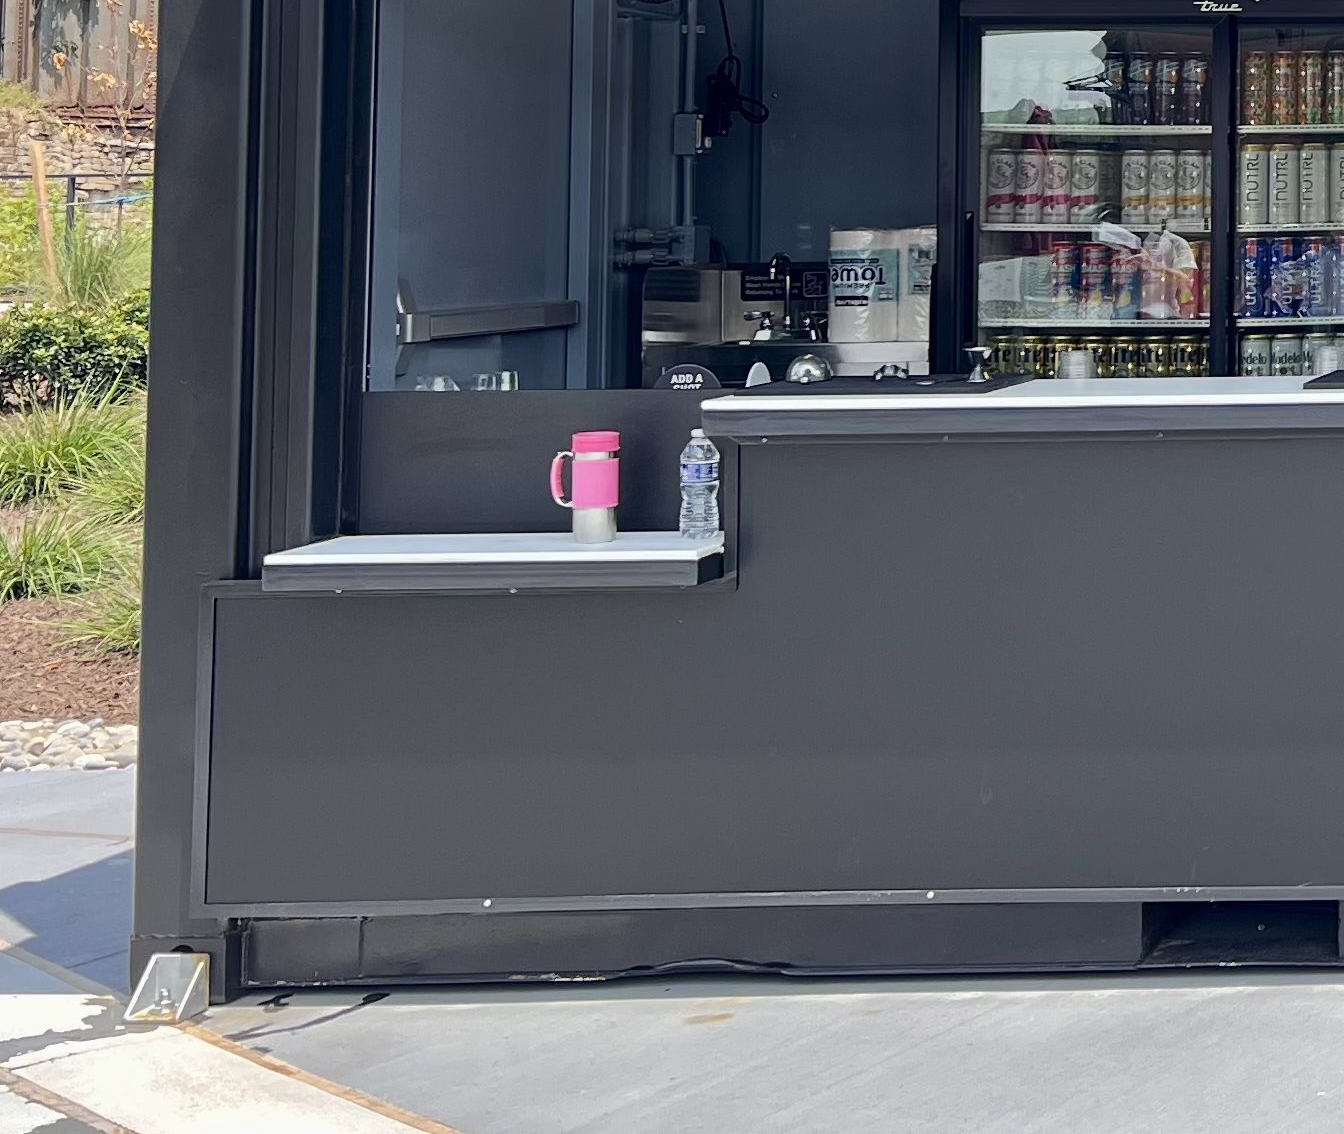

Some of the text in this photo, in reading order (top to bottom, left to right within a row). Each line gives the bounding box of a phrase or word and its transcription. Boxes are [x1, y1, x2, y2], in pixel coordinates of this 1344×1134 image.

[831, 266, 886, 286] Towe
[670, 373, 704, 384] ADD A
